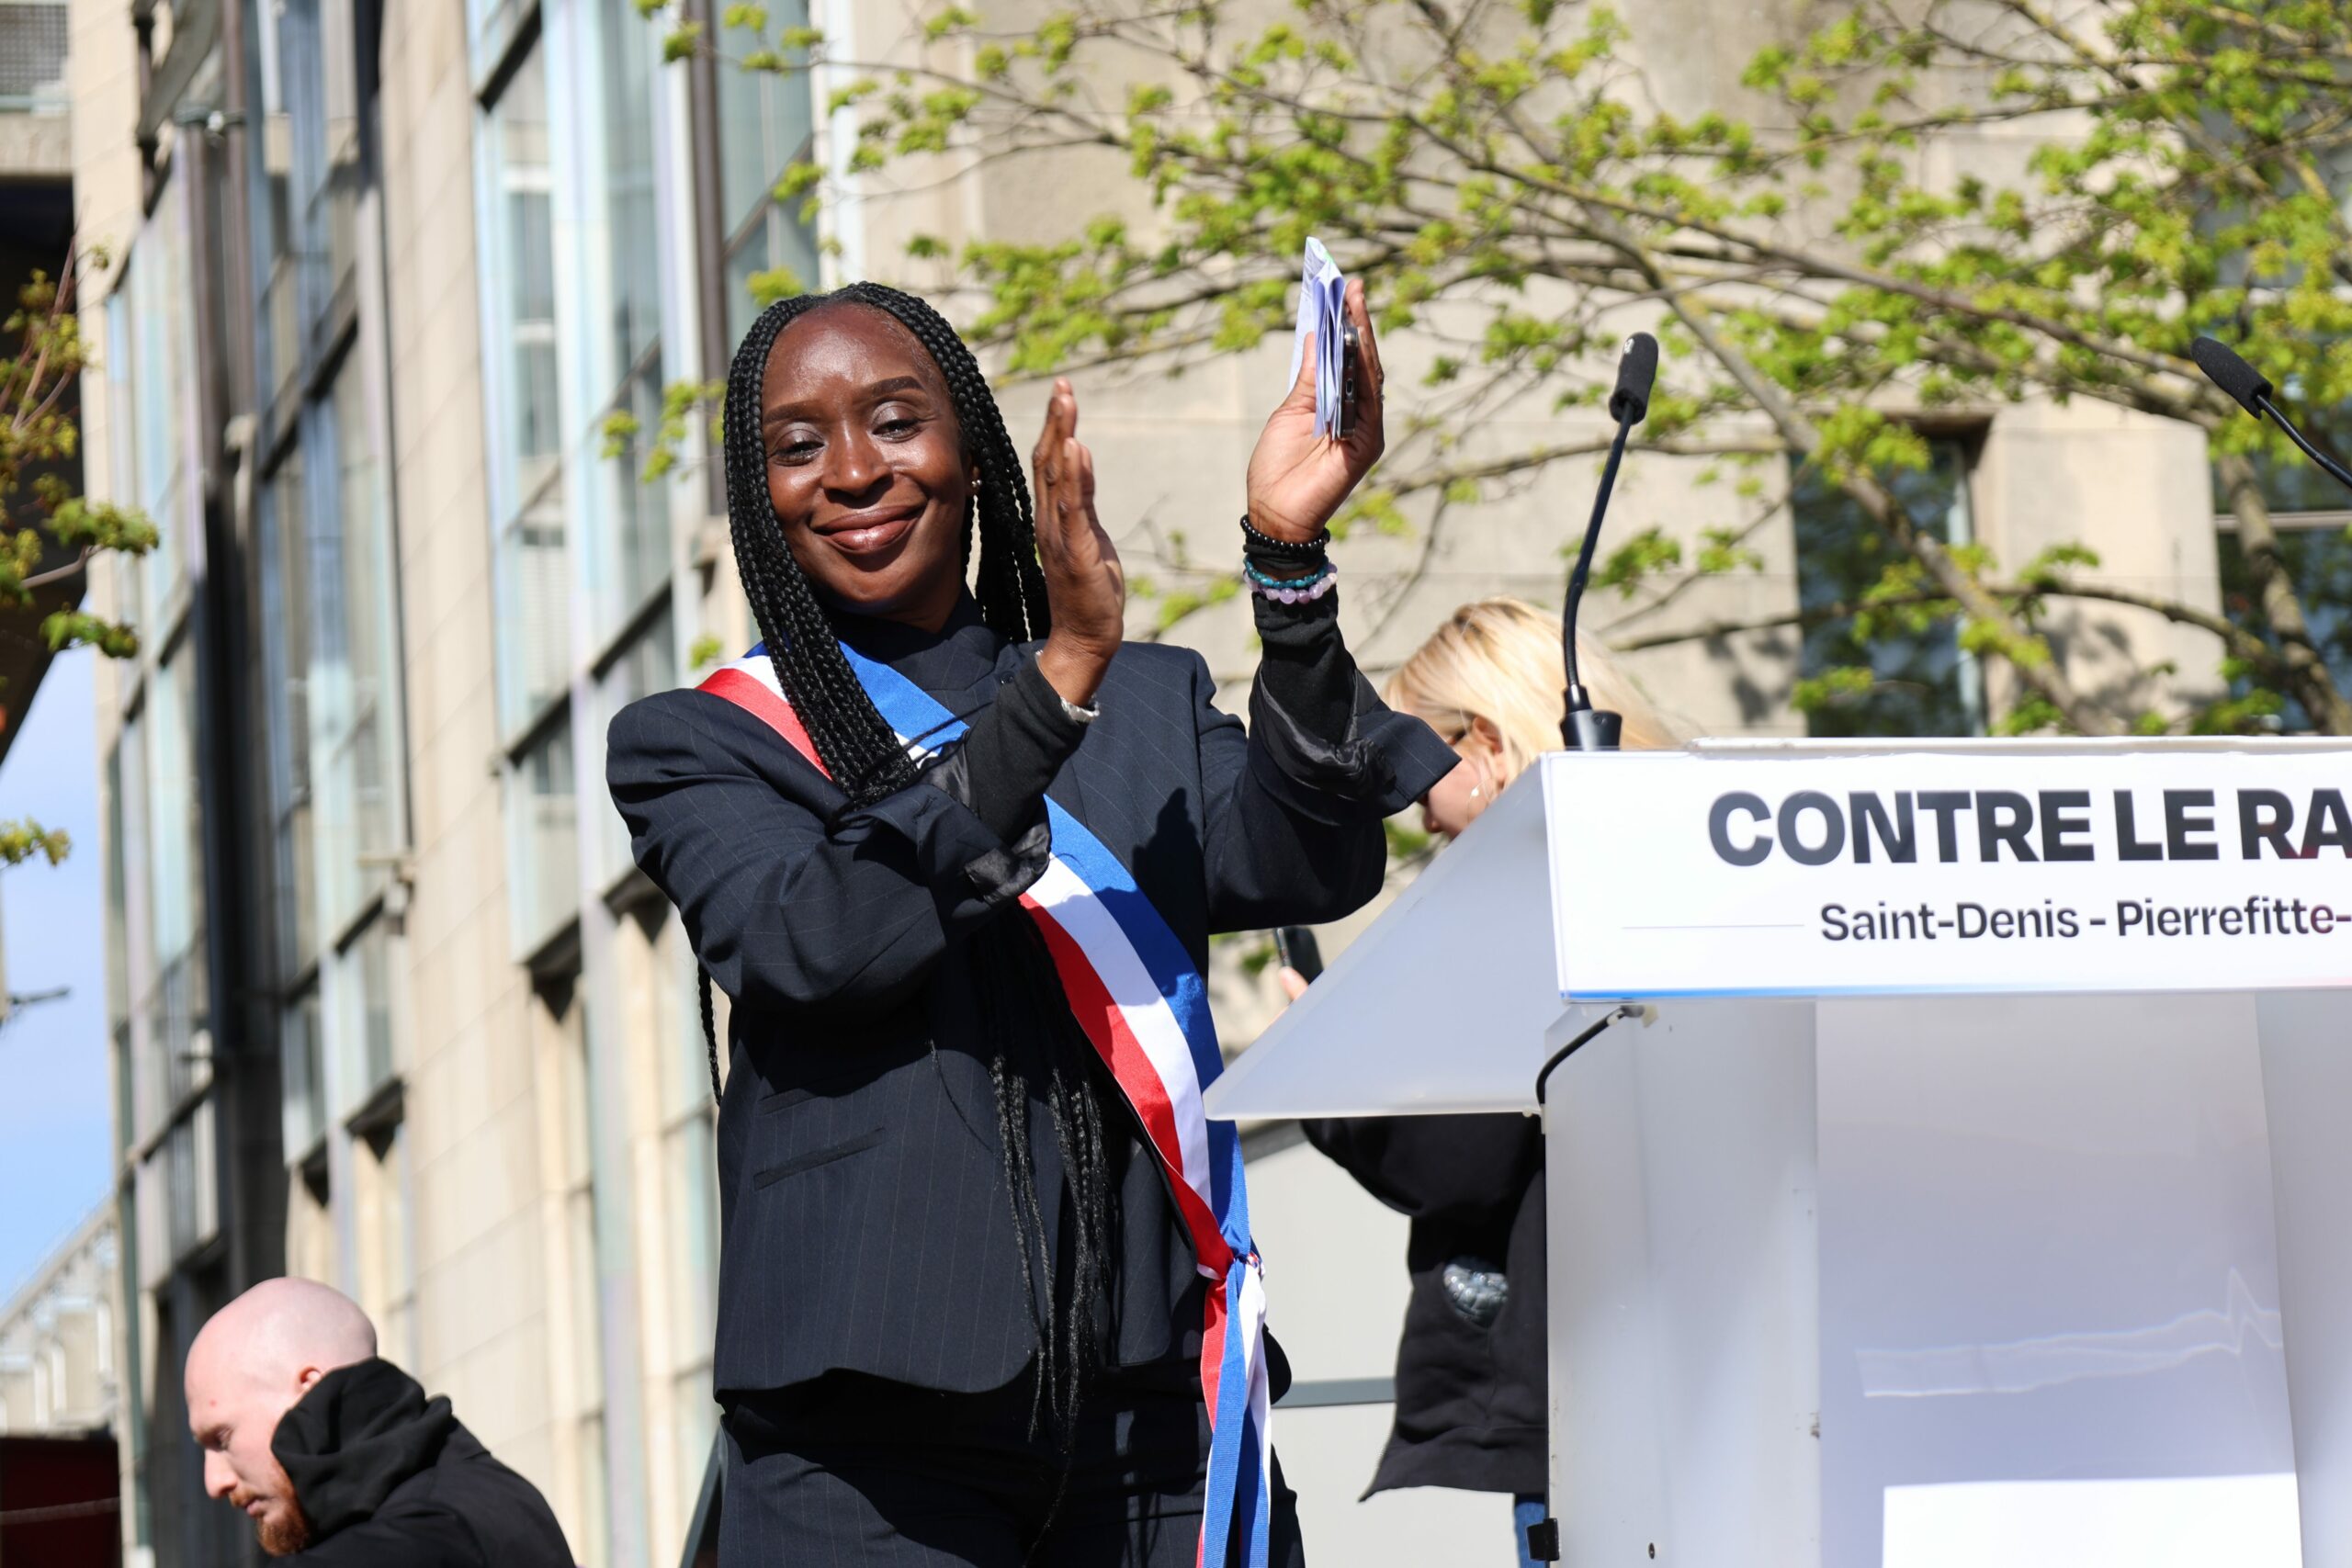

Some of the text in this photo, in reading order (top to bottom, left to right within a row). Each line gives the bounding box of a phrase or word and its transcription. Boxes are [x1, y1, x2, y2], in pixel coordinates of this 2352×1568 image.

[1708, 788, 2352, 867] CONTRE LE RA
[1821, 899, 2080, 942] Saint-Denis
[2117, 896, 2352, 937] Pierrefitte-
